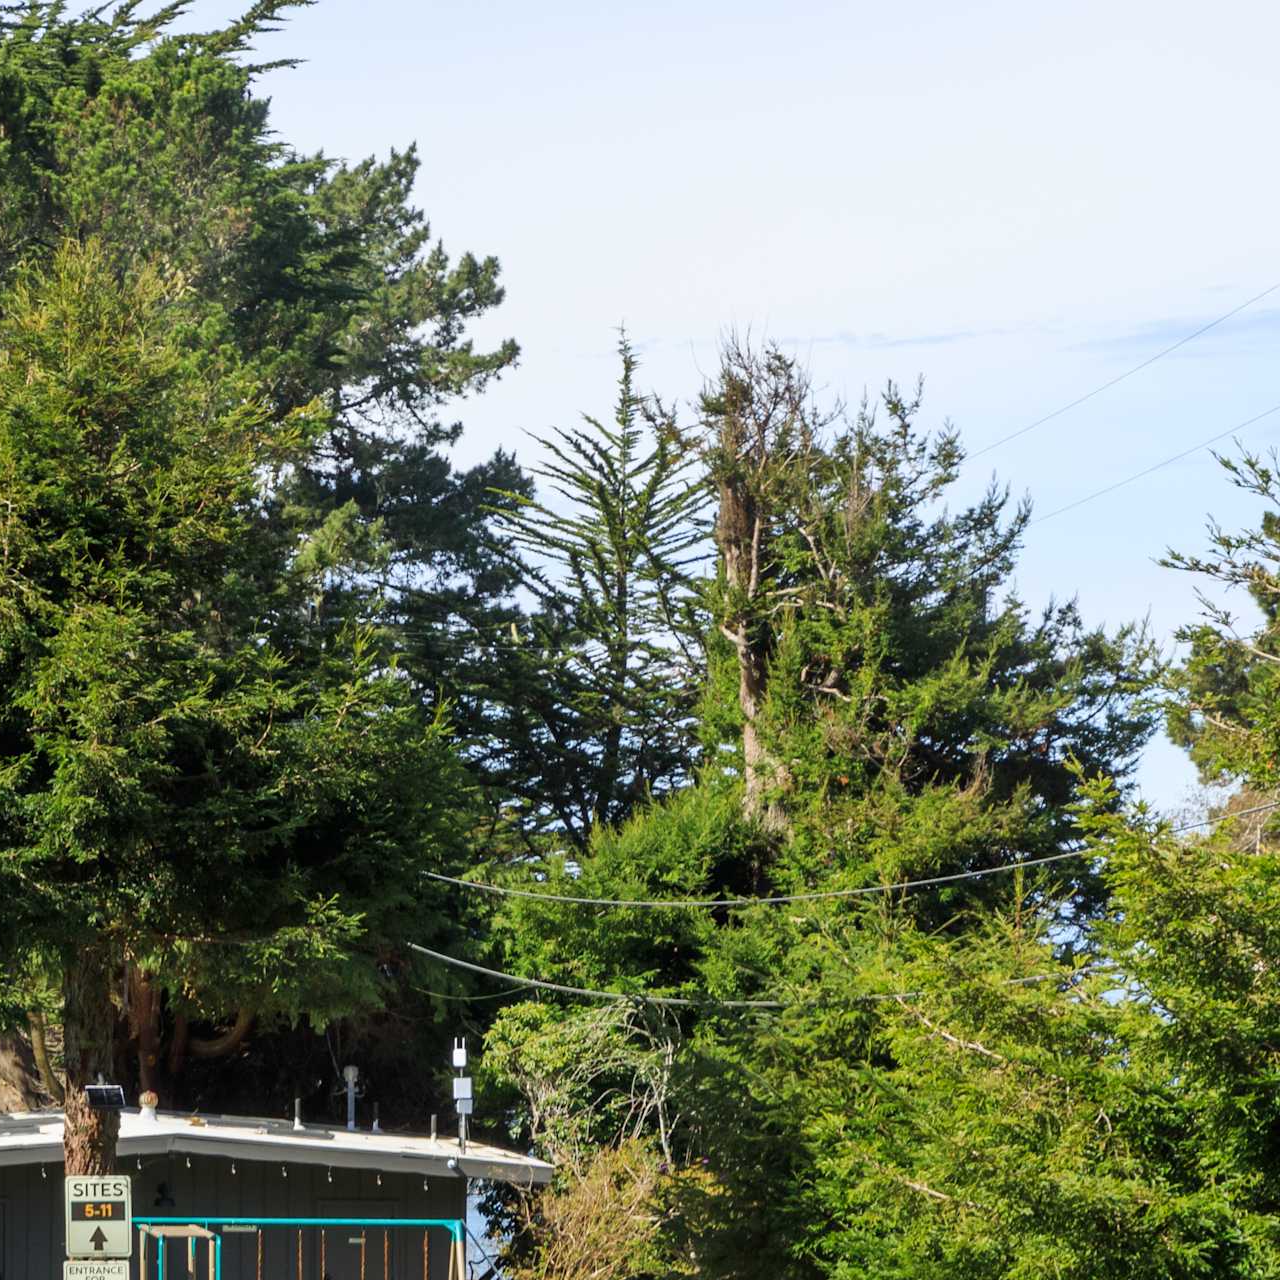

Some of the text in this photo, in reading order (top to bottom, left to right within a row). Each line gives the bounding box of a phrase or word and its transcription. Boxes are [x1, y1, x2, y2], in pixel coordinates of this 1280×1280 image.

[73, 1183, 123, 1197] SITES
[84, 1203, 112, 1217] 5-11
[69, 1266, 124, 1275] ENTRANCE
